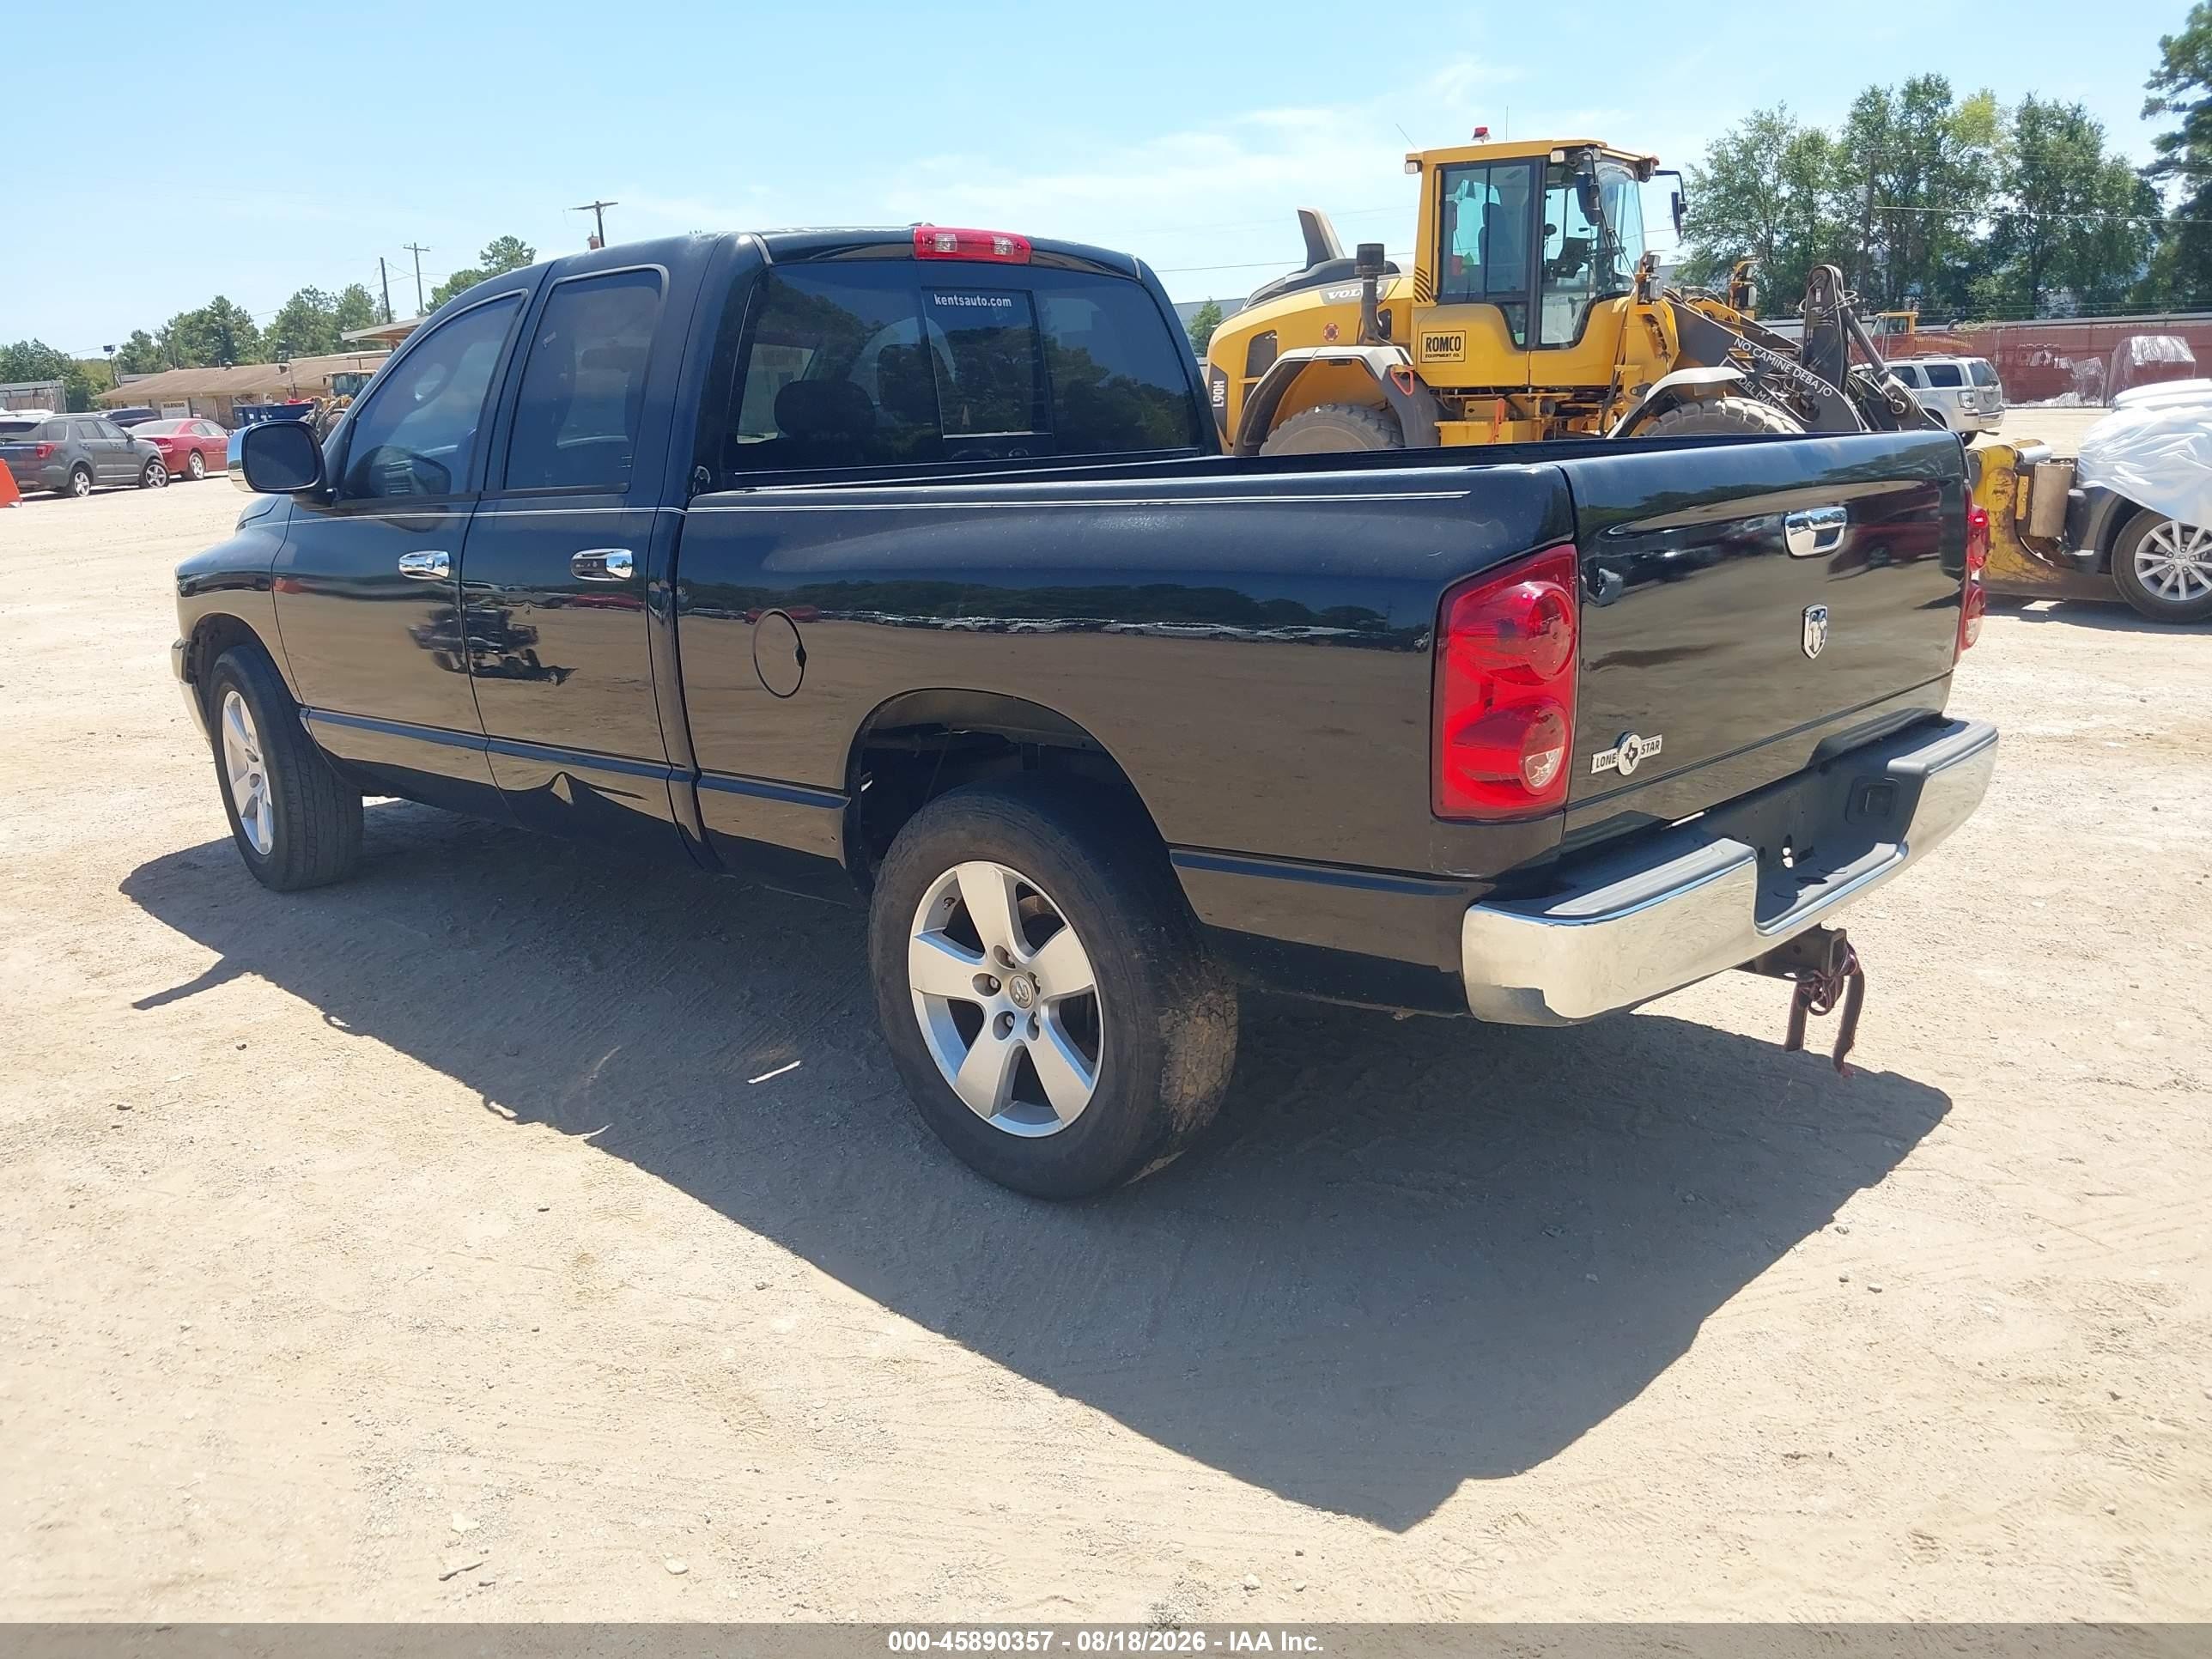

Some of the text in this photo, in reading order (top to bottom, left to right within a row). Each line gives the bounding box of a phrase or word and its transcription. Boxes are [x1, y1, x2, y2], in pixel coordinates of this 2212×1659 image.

[933, 293, 1012, 307] kentsauto.com
[1328, 285, 1383, 300] VOLO
[1425, 335, 1462, 353] ROMCO
[1733, 337, 1833, 398] NO CAMINE DEBAJO
[1738, 376, 1757, 392] DEL
[1212, 380, 1225, 409] L90H
[1595, 739, 1661, 769] LONE STAR
